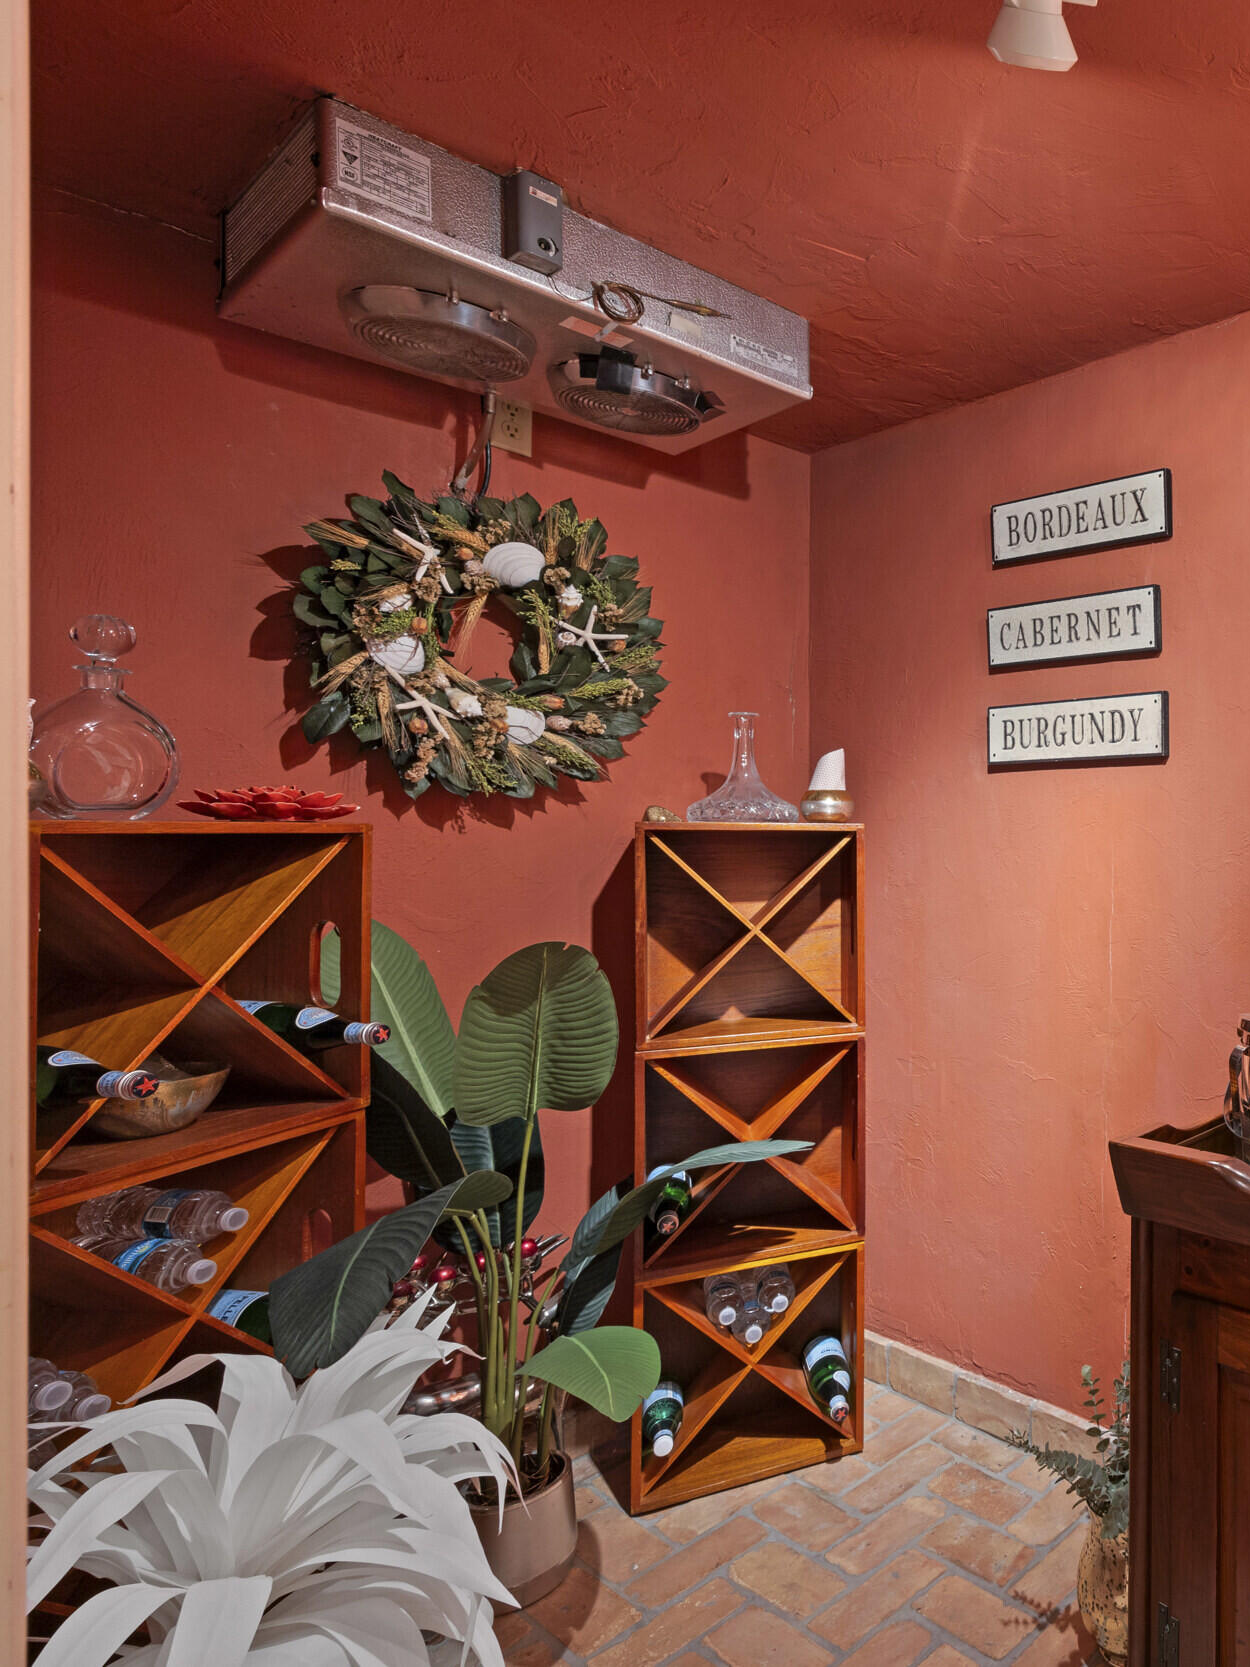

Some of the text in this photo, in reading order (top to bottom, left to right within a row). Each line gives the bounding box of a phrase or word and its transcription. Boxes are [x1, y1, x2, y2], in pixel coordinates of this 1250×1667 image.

[1006, 487, 1149, 548] BORDEAUX
[1000, 603, 1142, 651] CABERNET
[1001, 708, 1144, 751] BURGUNDY
